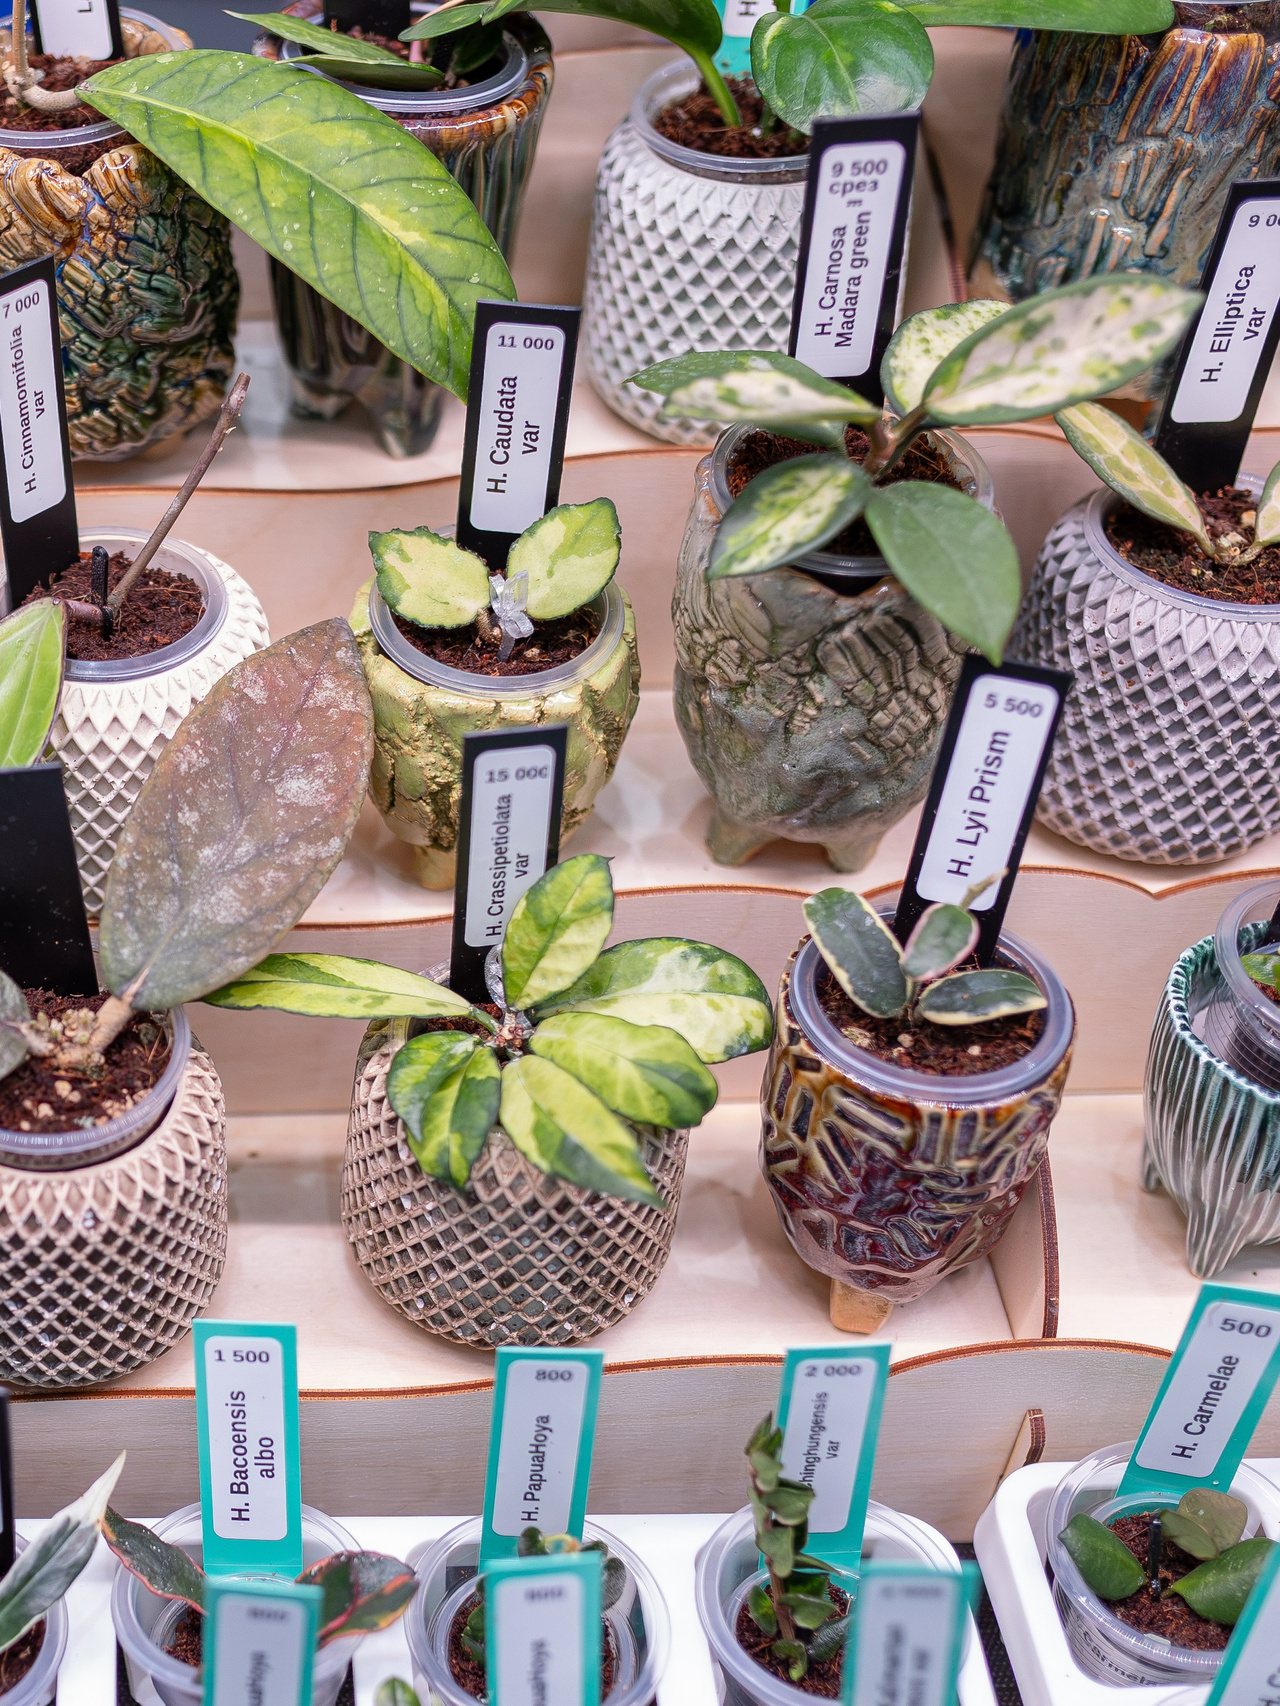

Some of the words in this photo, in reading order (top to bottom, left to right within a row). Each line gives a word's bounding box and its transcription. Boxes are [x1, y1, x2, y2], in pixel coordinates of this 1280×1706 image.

[831, 161, 844, 178] 9
[851, 158, 888, 177] 500
[1248, 214, 1260, 228] 9
[818, 224, 848, 311] Carnosa
[834, 275, 863, 349] Madara
[850, 210, 872, 269] green
[2, 303, 11, 319] 7
[15, 291, 41, 314] 000
[1209, 264, 1256, 354] Elliptica
[814, 315, 833, 338] H.
[1243, 307, 1267, 342] var
[497, 335, 517, 348] 11
[523, 337, 554, 351] 000
[1199, 361, 1223, 383] H.
[10, 324, 34, 470] Cinnamomifolia
[34, 389, 46, 420] var
[489, 375, 518, 465] Caudata
[521, 420, 541, 455] var
[24, 472, 37, 495] H.
[486, 473, 507, 494] H.
[984, 693, 997, 708] 5
[1003, 698, 1043, 718] 500
[486, 769, 508, 783] 15
[970, 731, 1012, 803] Prism
[956, 809, 989, 846] Lyi
[488, 794, 513, 917] Crassipetiolata
[515, 853, 530, 879] var
[946, 855, 974, 877] H.
[485, 920, 502, 937] H.
[1220, 1318, 1272, 1338] 500
[214, 1349, 226, 1362] 1
[233, 1350, 270, 1363] 500
[535, 1369, 573, 1382] 800
[805, 1365, 818, 1377] 2
[823, 1365, 862, 1377] 000
[1183, 1355, 1239, 1435] Carmelae
[225, 1390, 249, 1495] Bacoensis
[798, 1391, 828, 1489] hinghungensis
[826, 1440, 840, 1460] var
[1171, 1442, 1198, 1459] H.
[254, 1436, 275, 1479] albo
[523, 1414, 553, 1502] PapuaHoya
[231, 1502, 250, 1522] H.
[521, 1506, 539, 1521] H.
